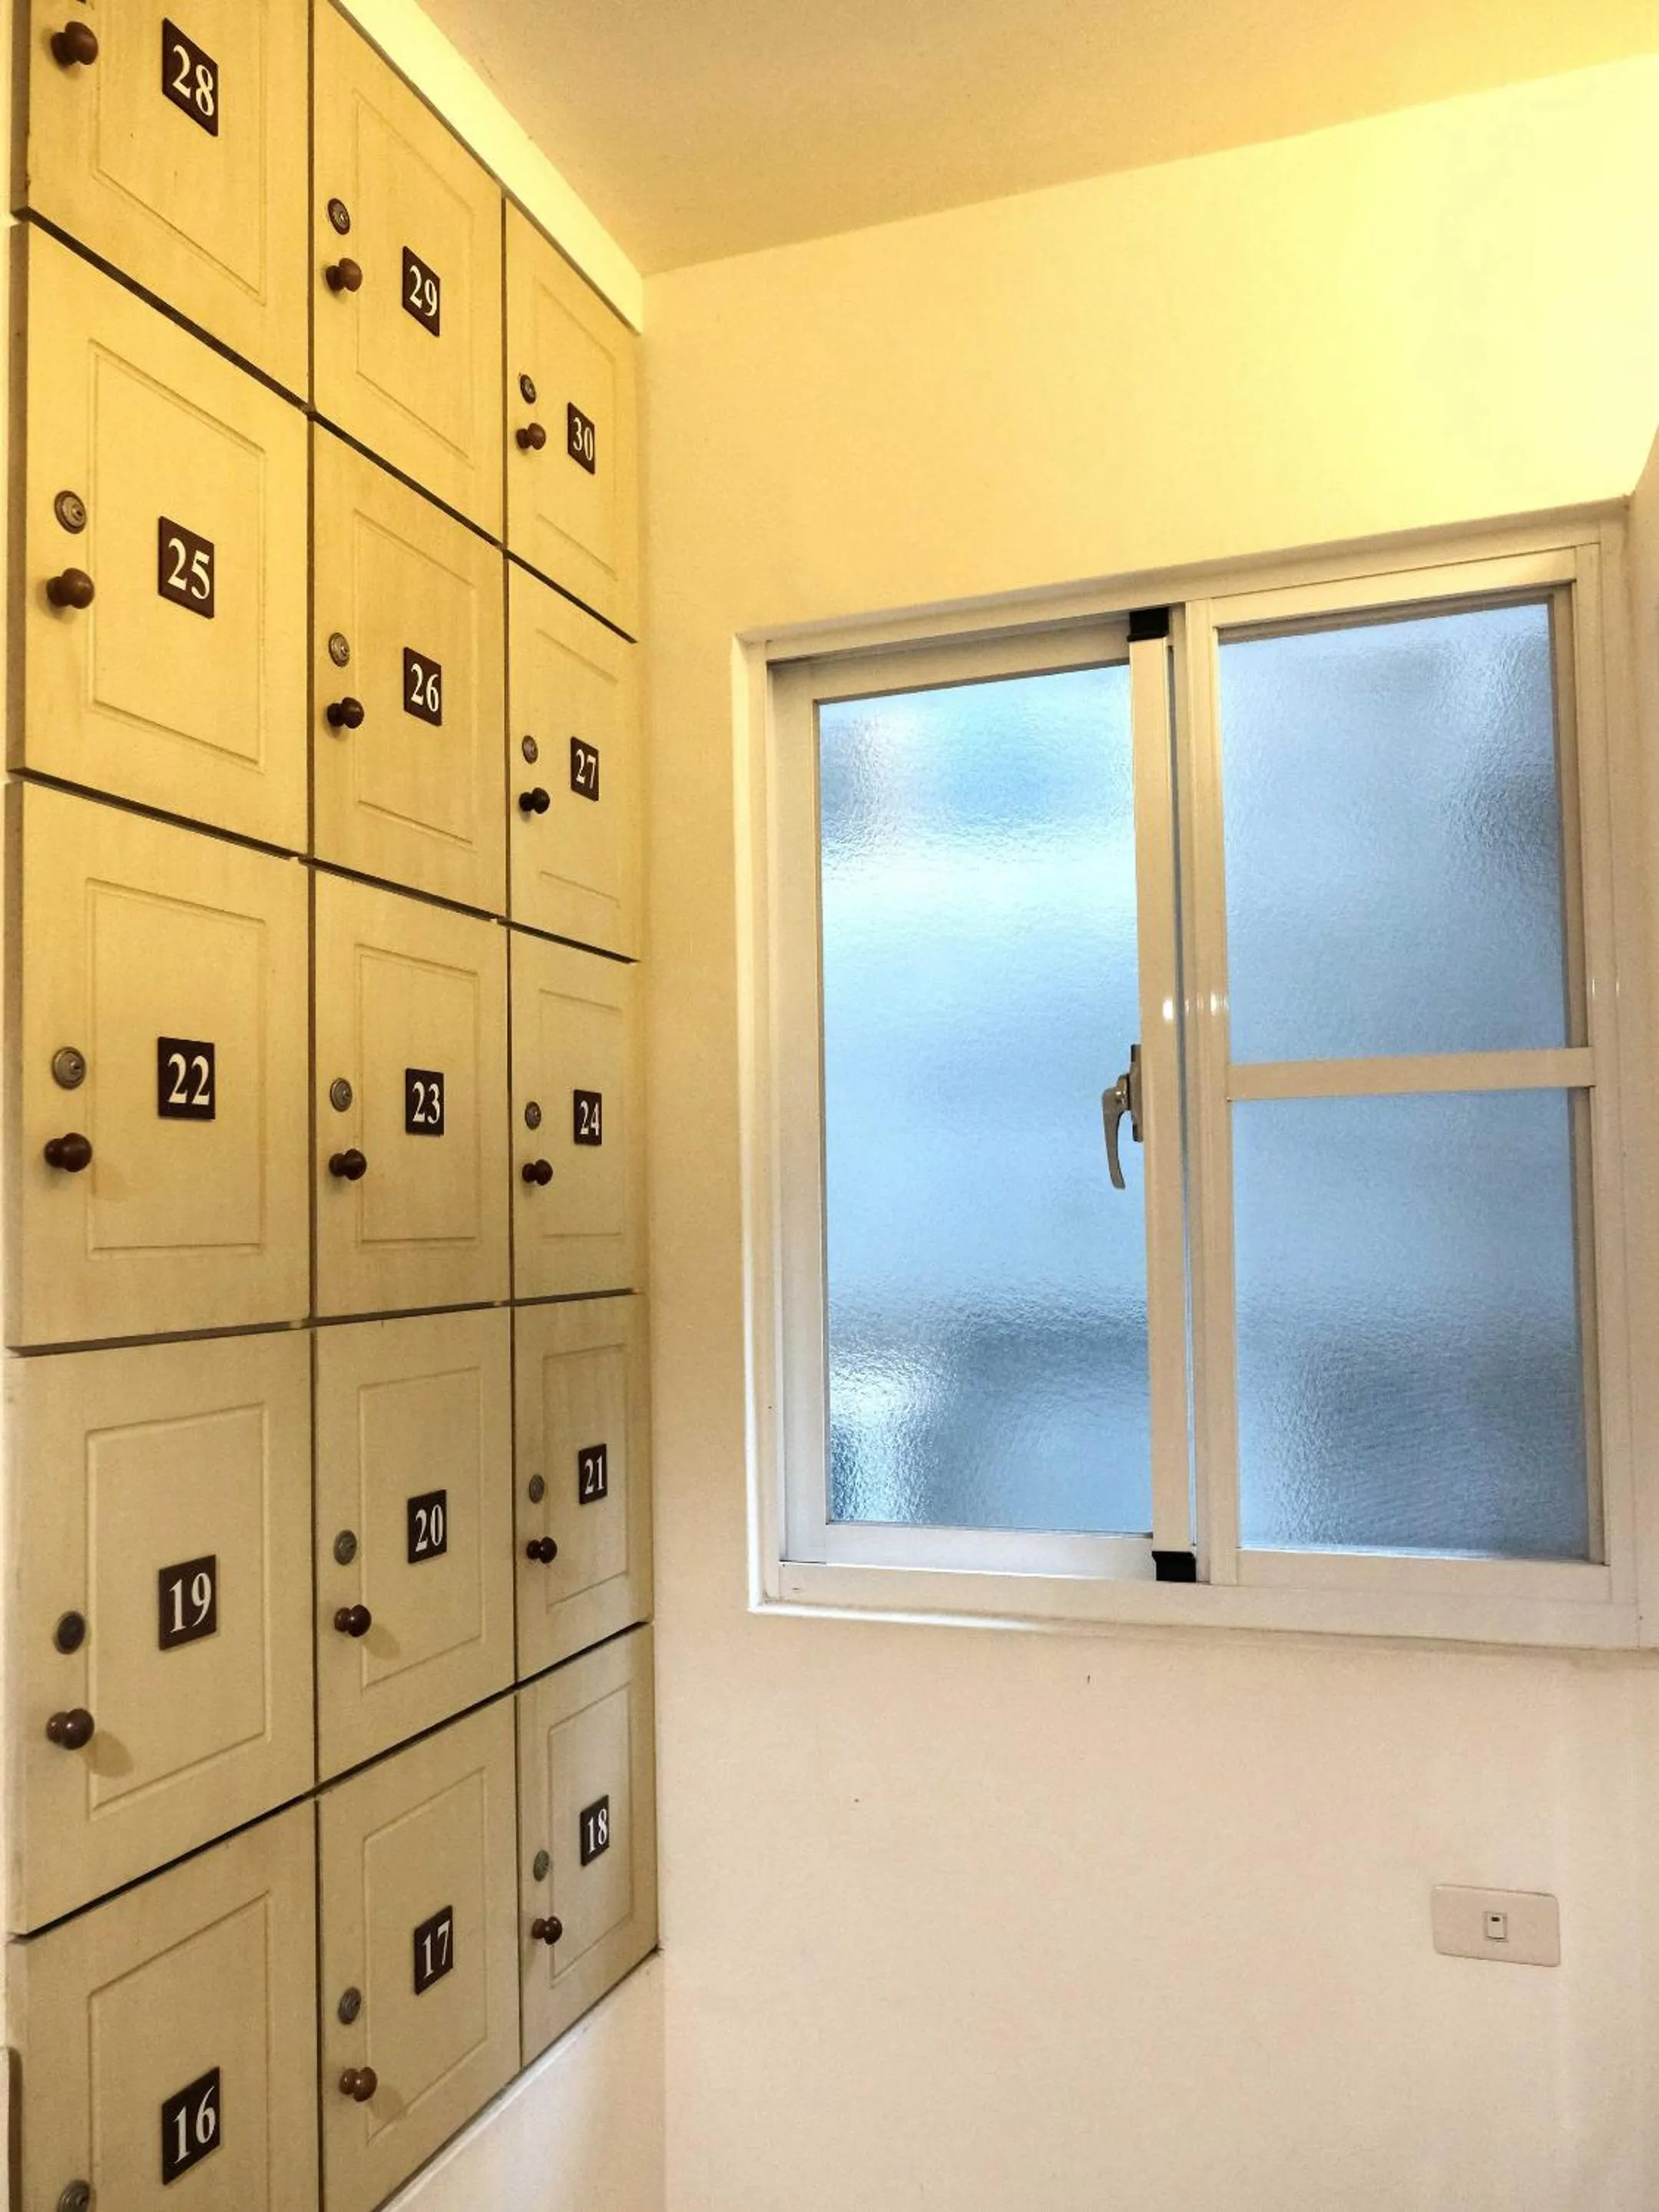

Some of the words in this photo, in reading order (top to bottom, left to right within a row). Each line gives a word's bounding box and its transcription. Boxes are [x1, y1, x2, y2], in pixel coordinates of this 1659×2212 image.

[173, 45, 214, 116] 28
[410, 266, 438, 316] 29
[574, 417, 594, 460] 30
[168, 538, 210, 599] 25
[411, 664, 439, 713] 26
[577, 748, 597, 789] 27
[169, 1053, 210, 1104] 22
[412, 1081, 440, 1124] 23
[580, 1100, 600, 1135] 24
[585, 1456, 604, 1494] 21
[415, 1504, 443, 1551] 20
[170, 1573, 212, 1632] 19
[588, 1808, 608, 1853] 18
[423, 1920, 450, 1979] 17
[174, 2086, 216, 2163] 16
